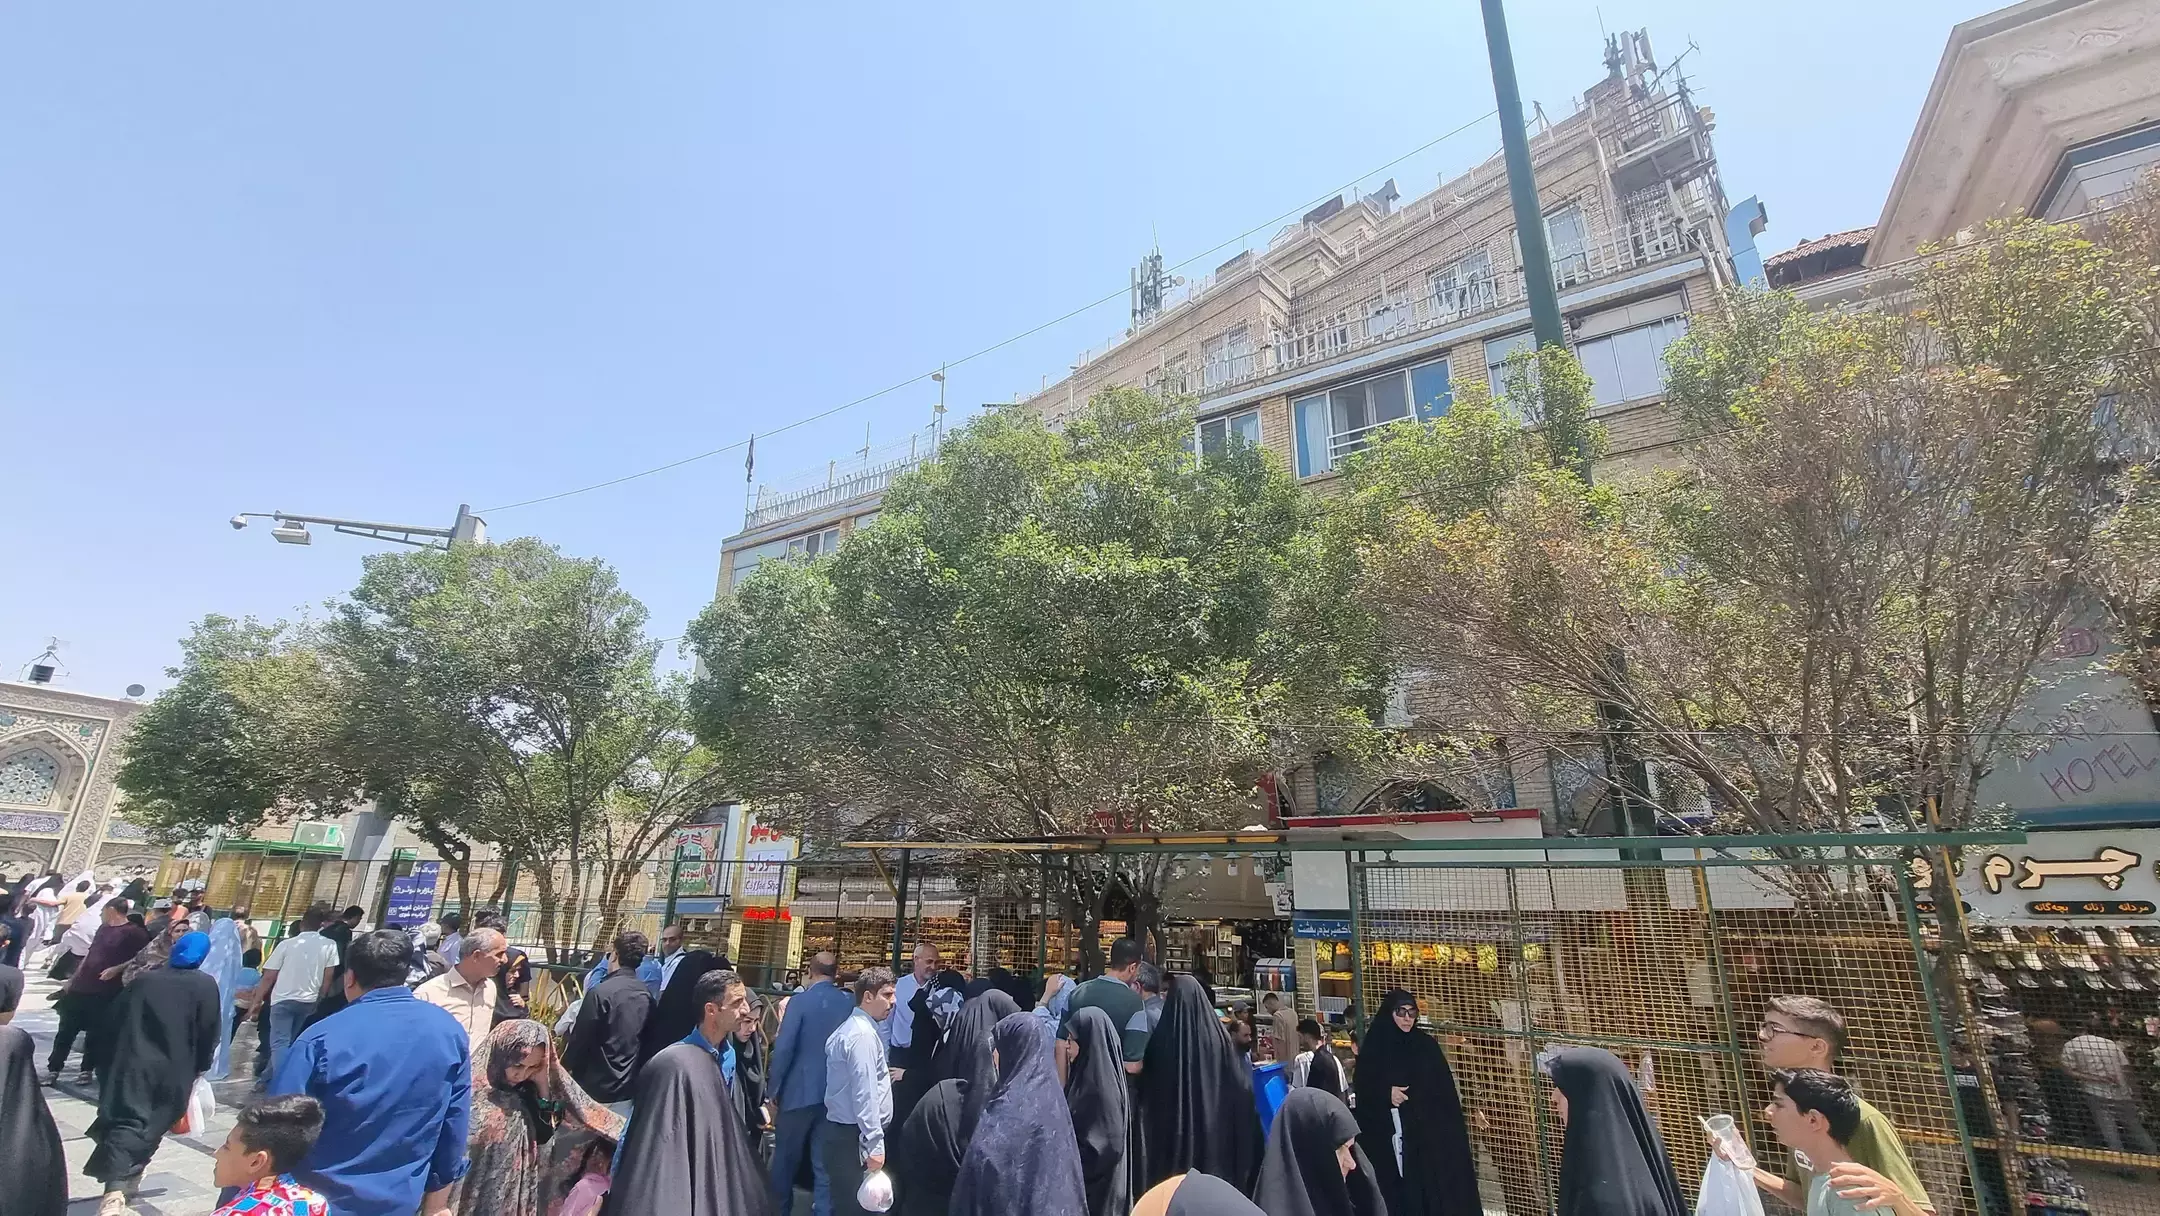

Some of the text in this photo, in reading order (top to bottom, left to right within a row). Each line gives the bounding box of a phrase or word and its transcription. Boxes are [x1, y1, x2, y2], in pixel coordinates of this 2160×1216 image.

[2040, 741, 2159, 802] HOTEL
[1983, 847, 2141, 893] چرم
[420, 887, 434, 895] بازار
[745, 880, 766, 892] Coffee
[398, 904, 413, 912] شهید
[2083, 902, 2106, 914] زنانه
[2118, 902, 2150, 914] مردانه
[1331, 922, 1352, 937] اکشیر
